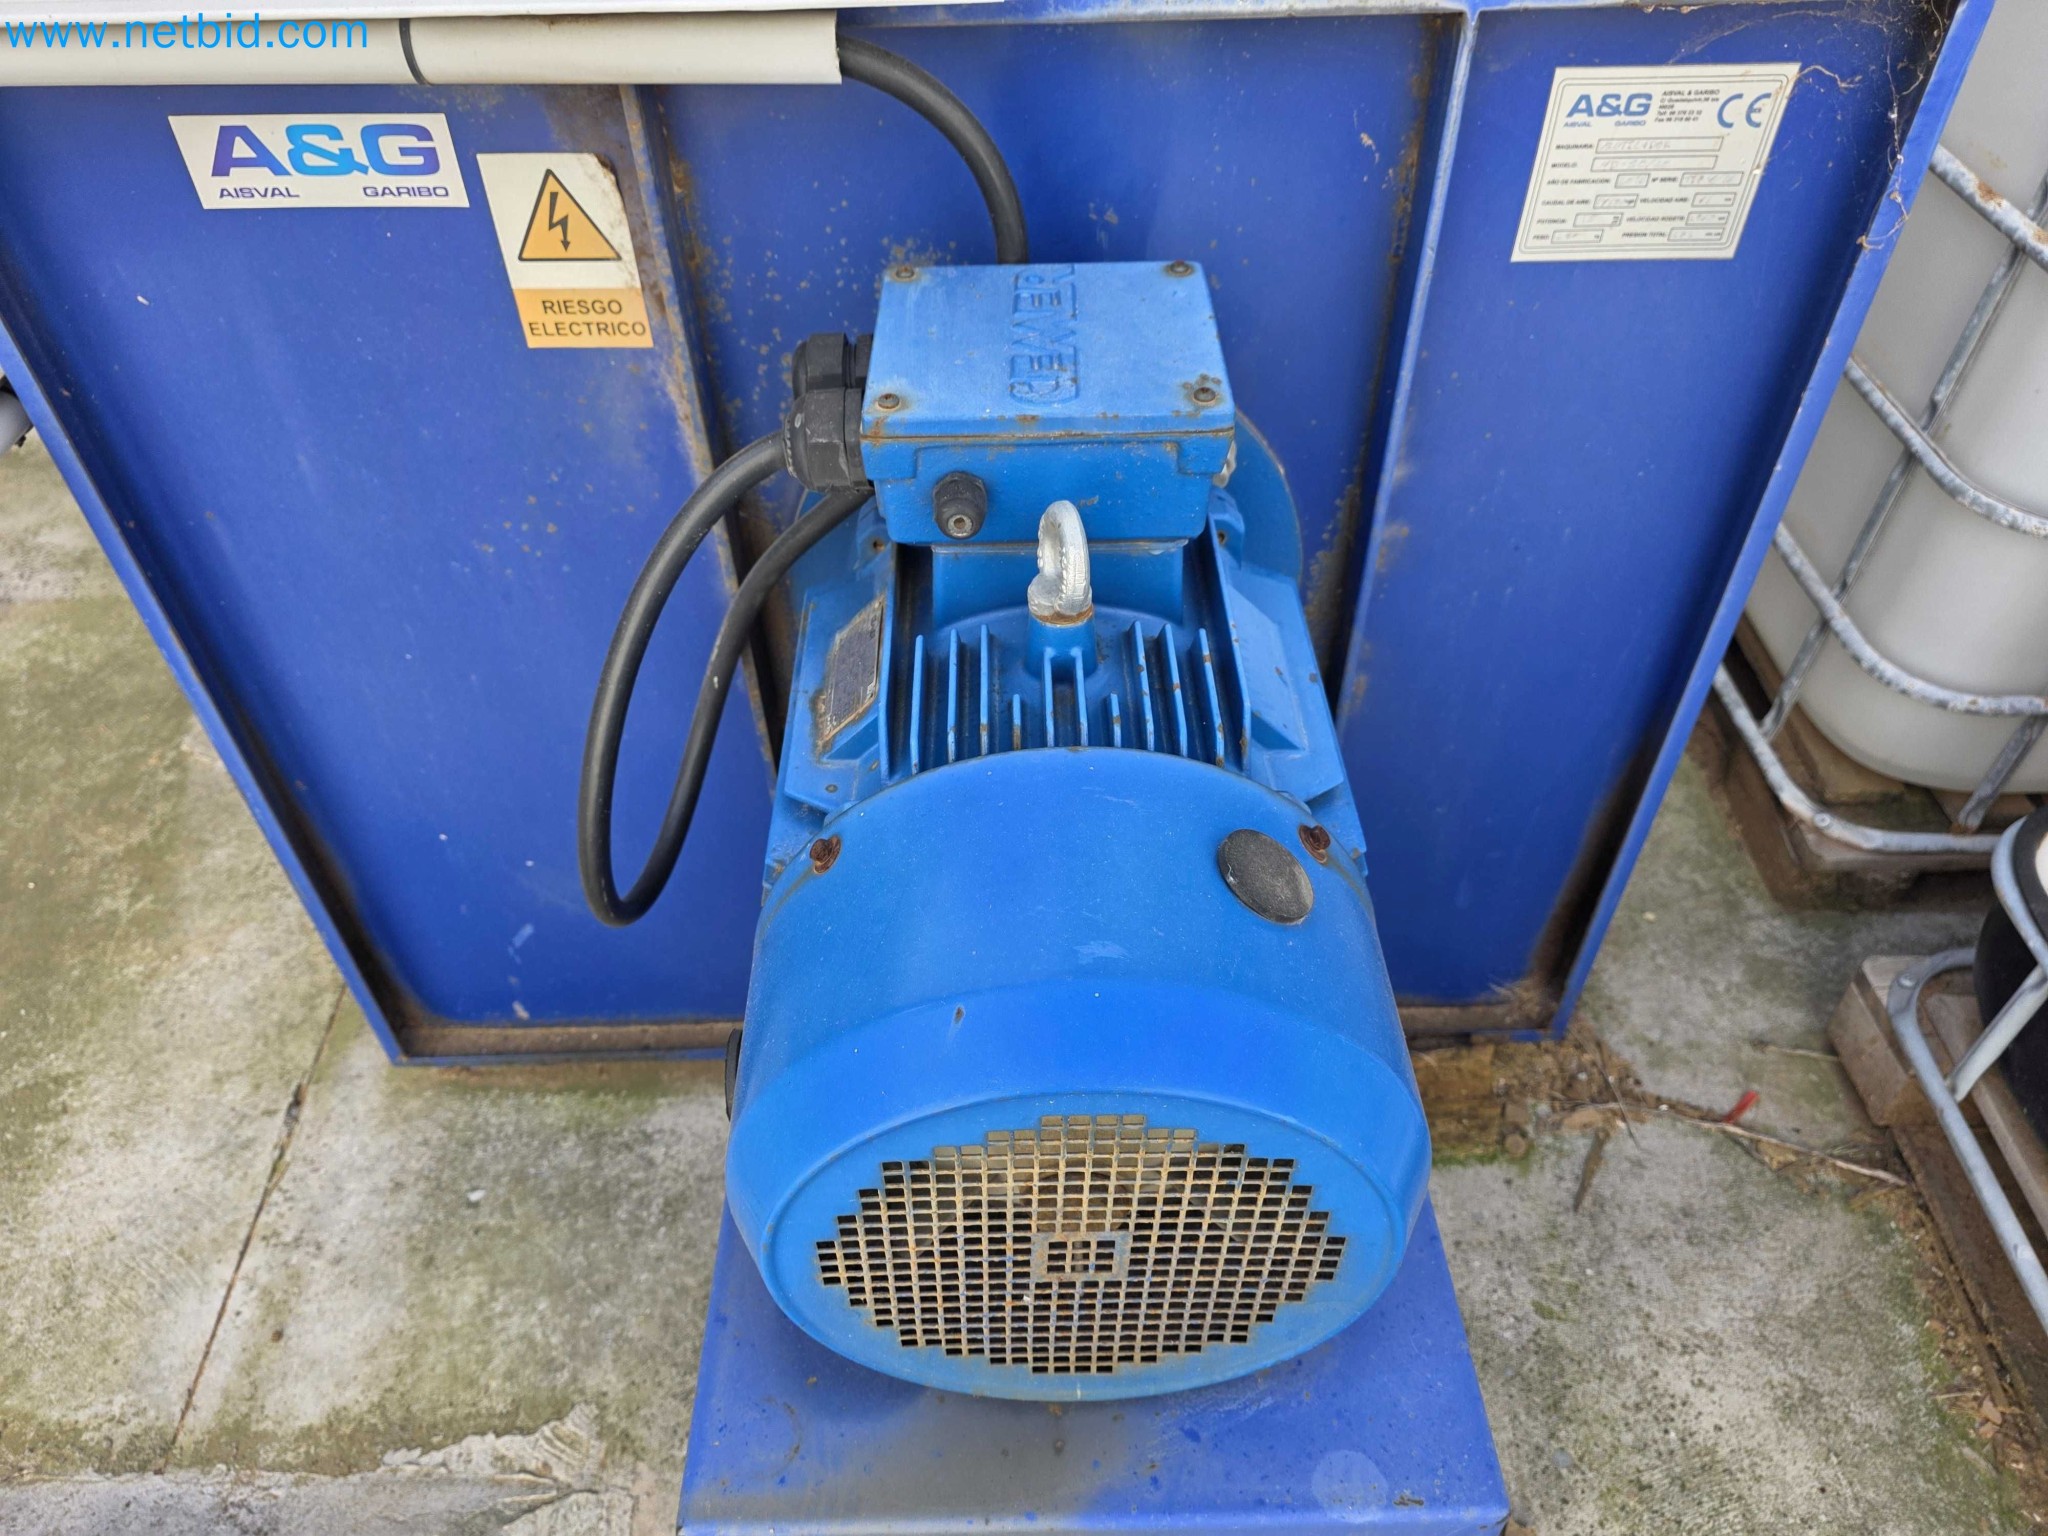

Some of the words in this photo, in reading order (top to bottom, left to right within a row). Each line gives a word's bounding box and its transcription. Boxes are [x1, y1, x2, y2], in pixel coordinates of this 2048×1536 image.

[1694, 88, 1721, 96] GARIBO
[1566, 93, 1653, 118] A&G
[209, 123, 439, 177] A&G
[218, 186, 301, 199] AISVAL
[362, 185, 451, 198] GARIBO
[541, 299, 623, 317] RIESGO
[528, 320, 648, 339] ELECTRICO
